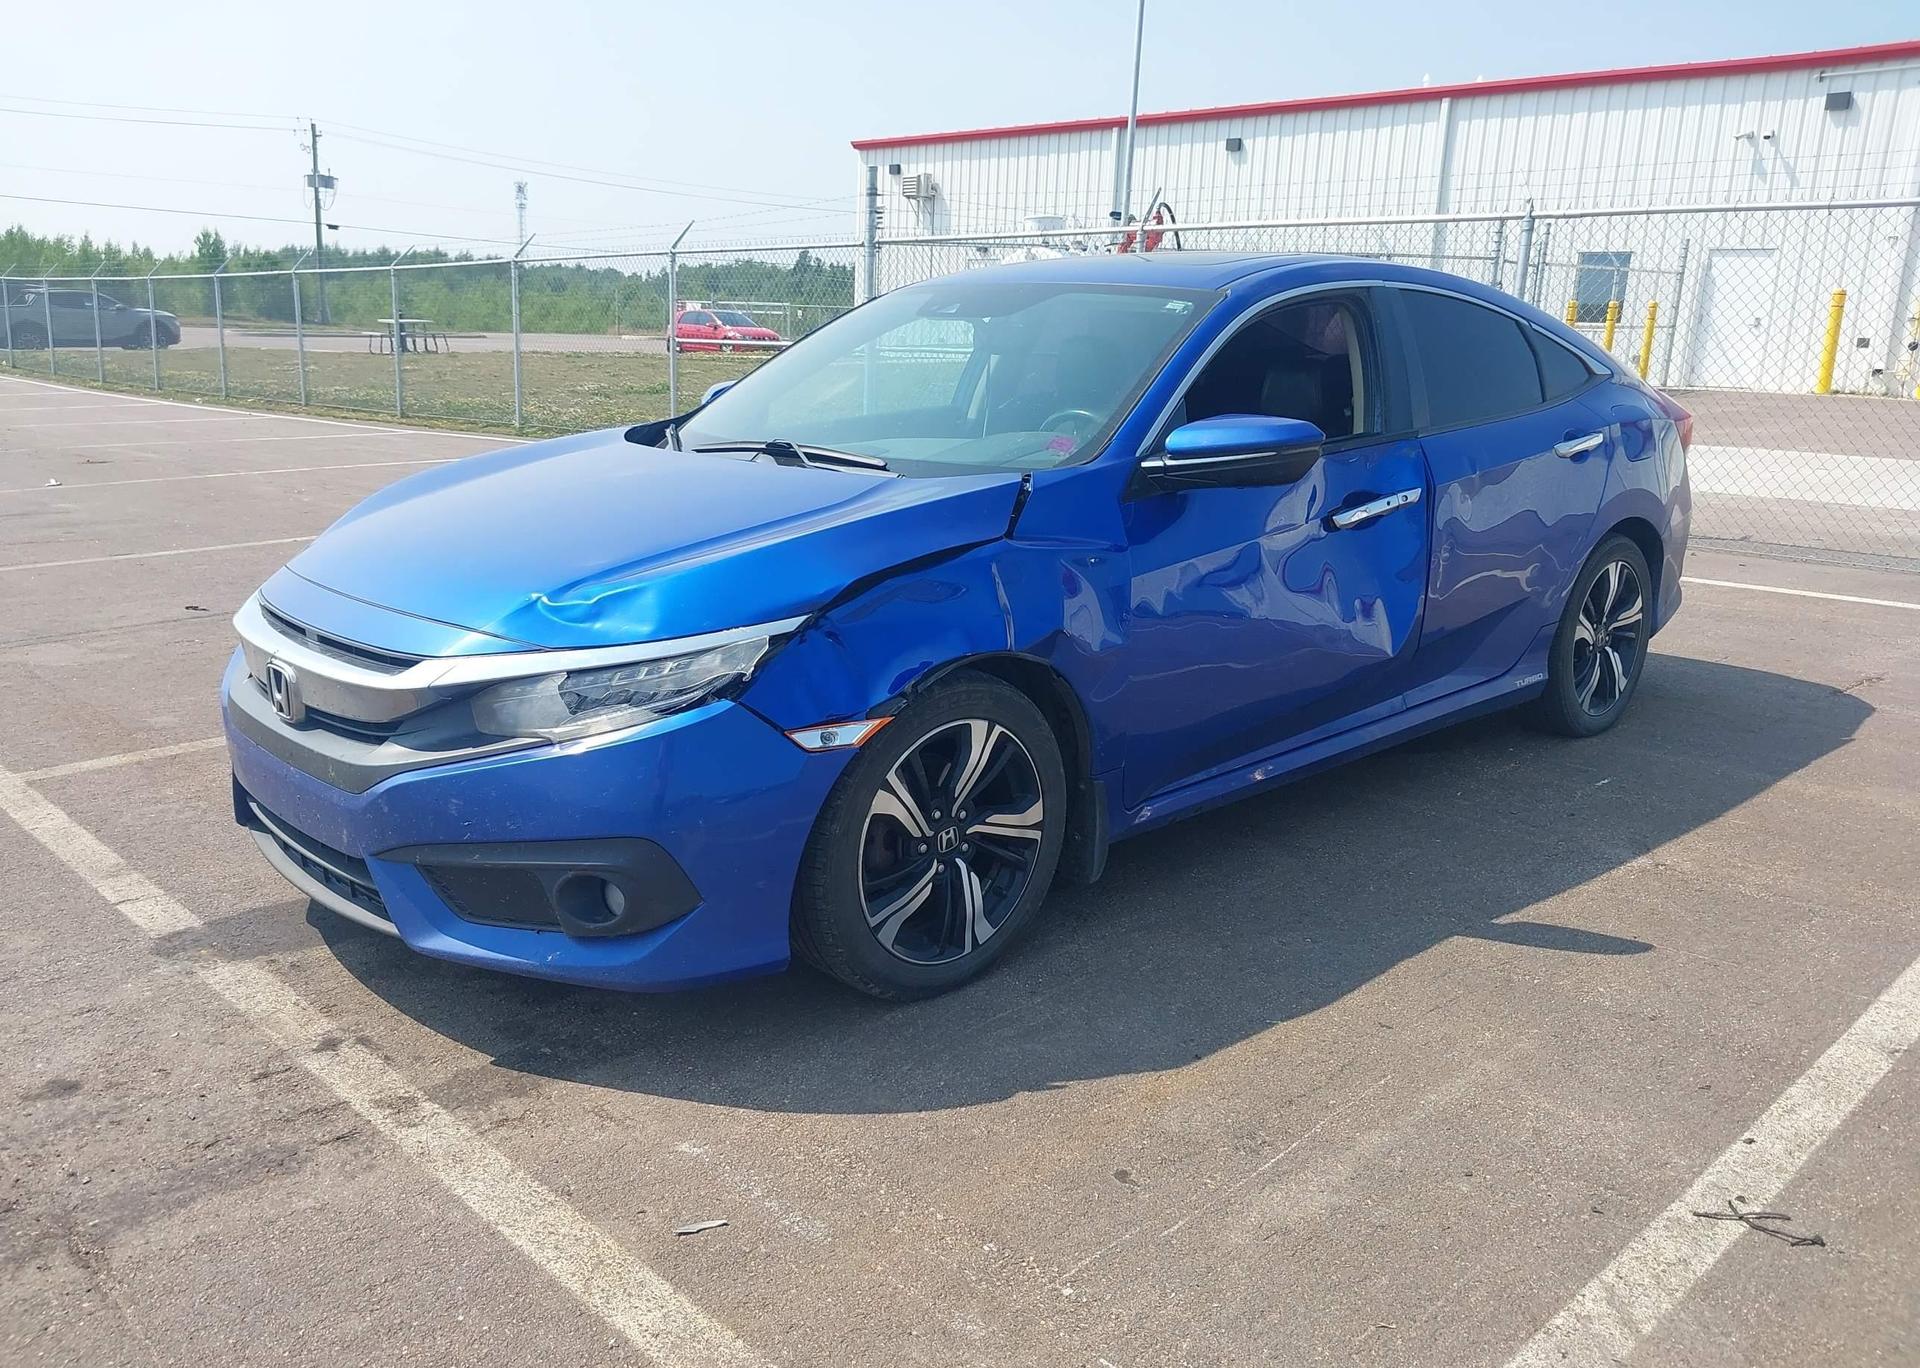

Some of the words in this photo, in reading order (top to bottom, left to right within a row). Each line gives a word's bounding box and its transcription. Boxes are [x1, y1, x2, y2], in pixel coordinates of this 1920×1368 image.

[266, 663, 292, 719] H
[1514, 672, 1544, 688] TURBO
[940, 827, 958, 851] H
